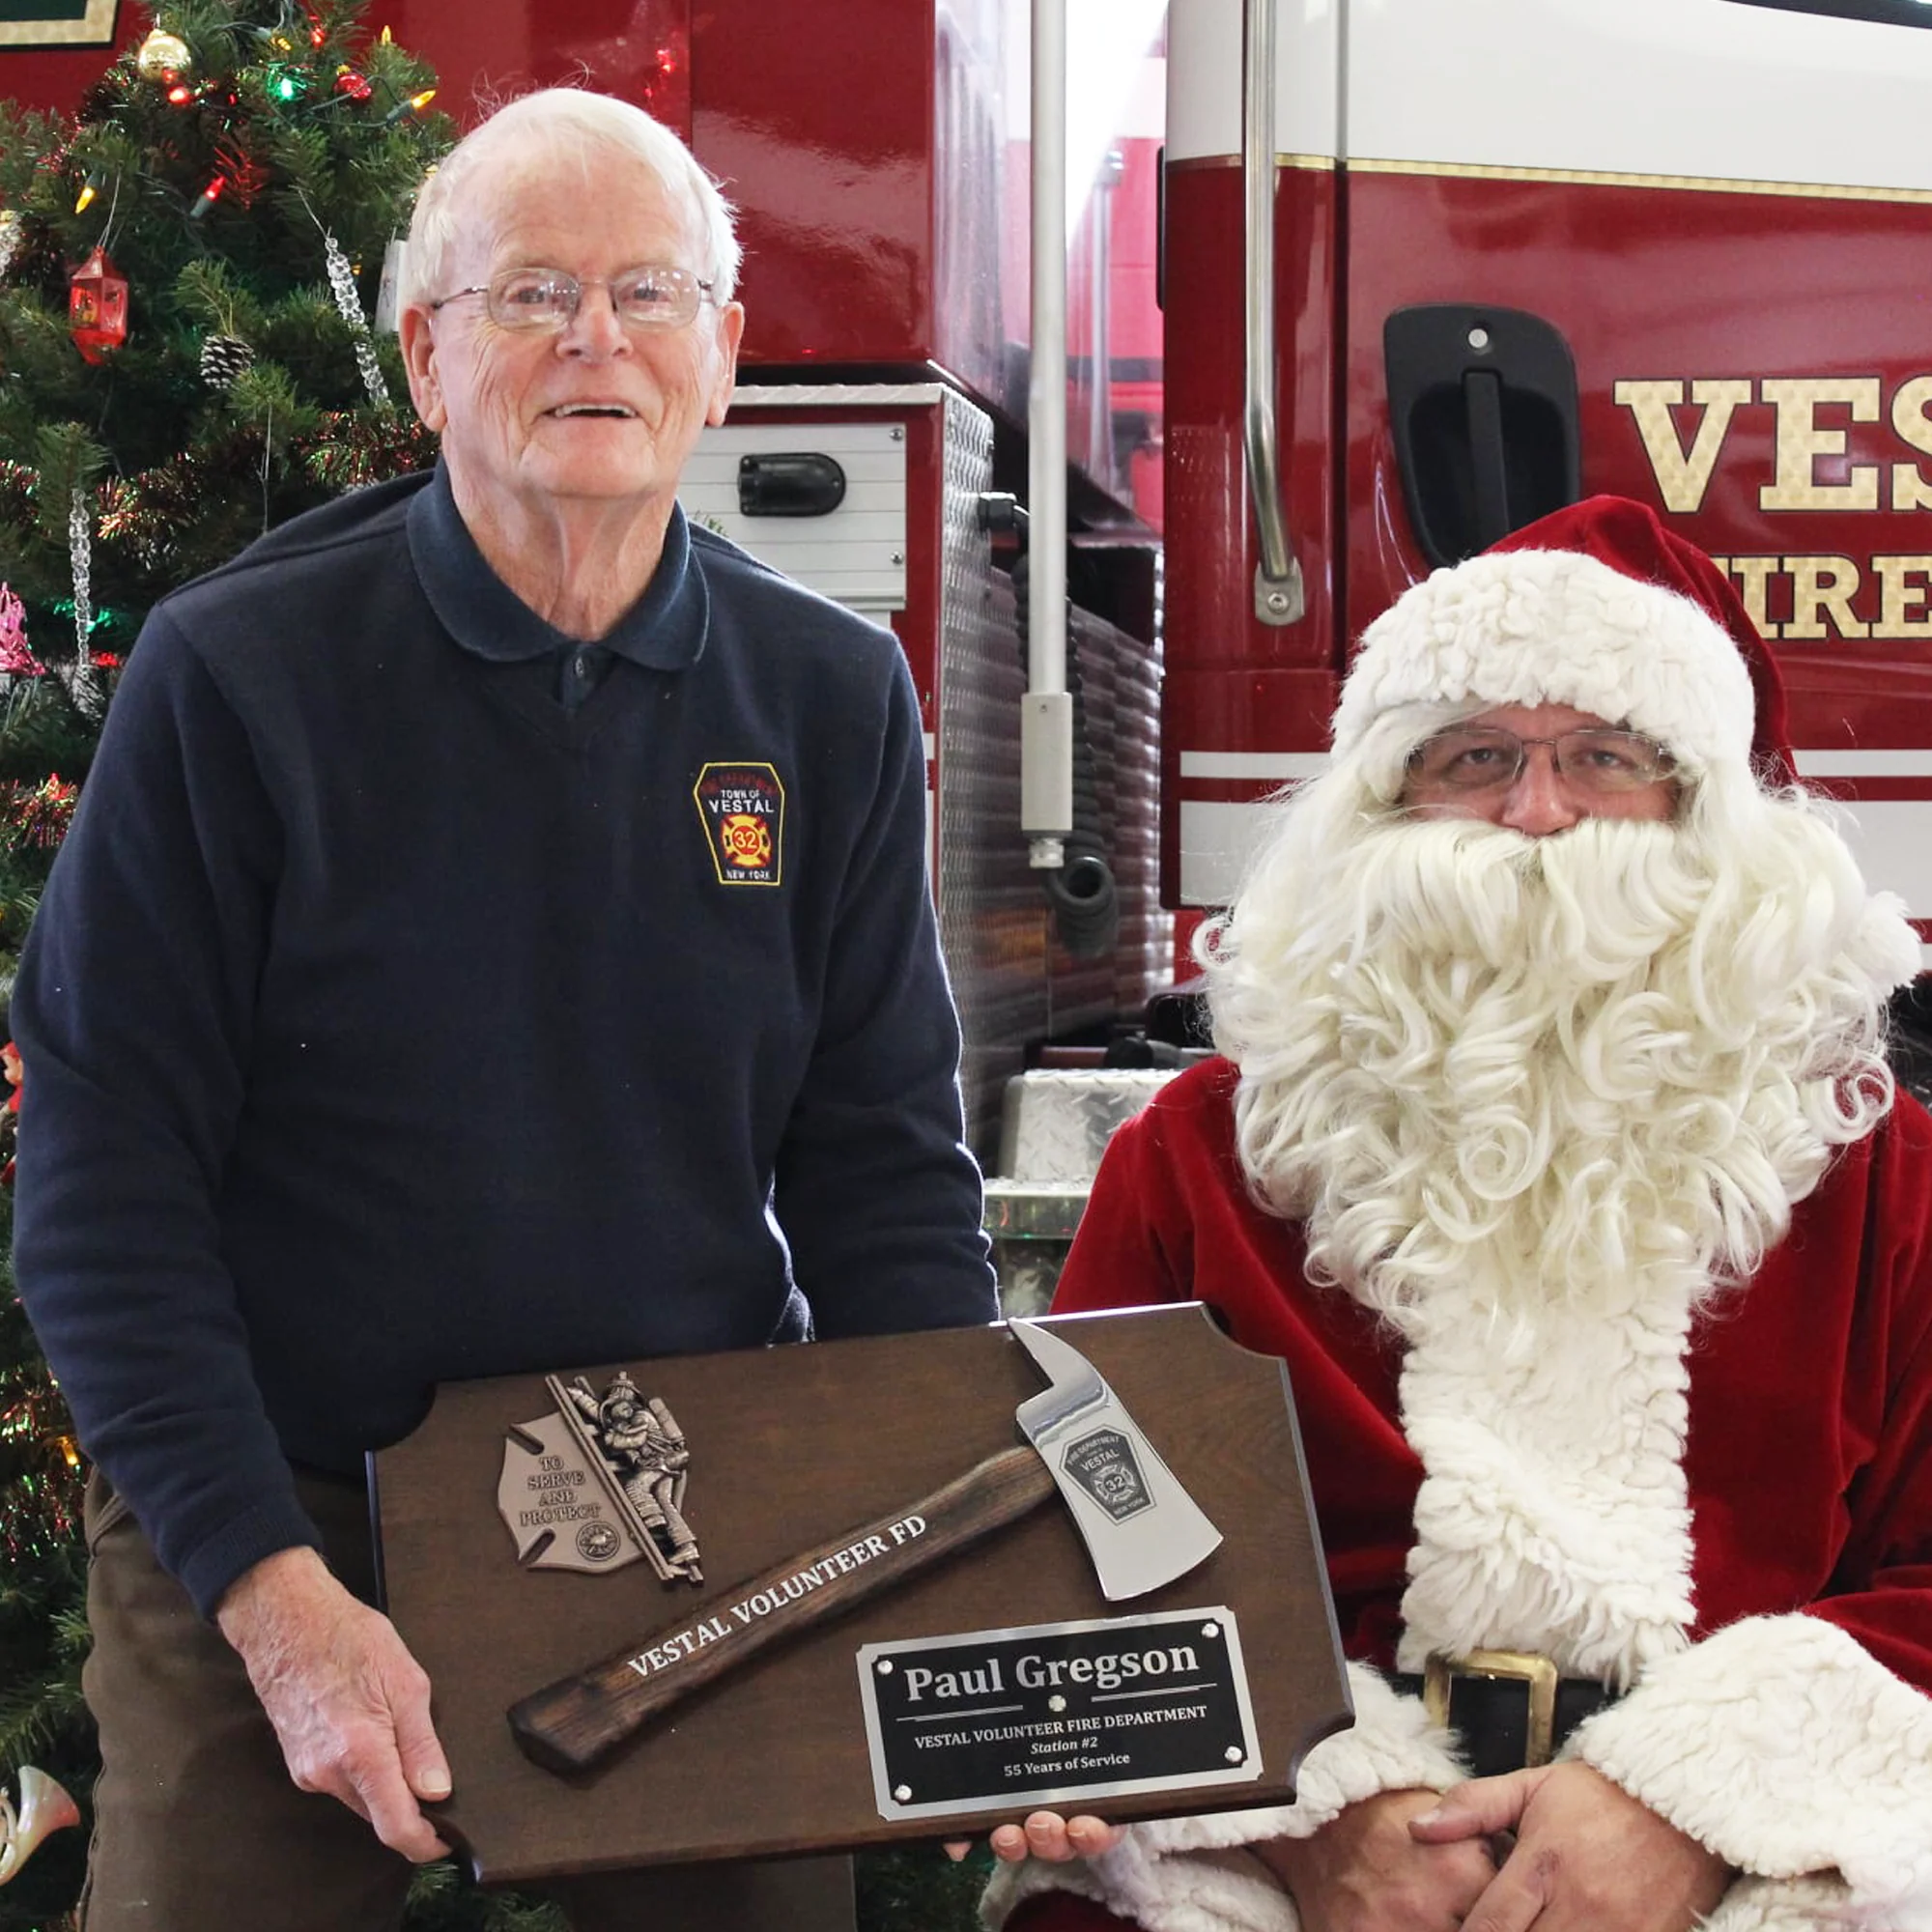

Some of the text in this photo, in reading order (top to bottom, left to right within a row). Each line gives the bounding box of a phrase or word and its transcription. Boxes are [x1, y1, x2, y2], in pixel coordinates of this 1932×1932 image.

[1711, 554, 1932, 639] IRE
[721, 789, 747, 799] TOWN
[709, 799, 775, 813] VESTAL
[734, 831, 757, 849] 32
[726, 869, 770, 880] NEW YORK
[539, 1456, 564, 1471] TO
[1081, 1449, 1120, 1471] VESTAL
[527, 1471, 585, 1490] SERVE
[1106, 1476, 1124, 1492] 32
[539, 1490, 578, 1506] AND
[520, 1503, 602, 1526] PROTECT
[628, 1516, 926, 1677] VESTAL VOLUNTEER FD
[904, 1646, 1200, 1701] Paul Gregson
[915, 1705, 1208, 1749] VESTAL VOLUNTEER FIRE DEPARTMENT
[1031, 1737, 1098, 1754] Station #2
[1004, 1752, 1130, 1776] 55 Years of Service
